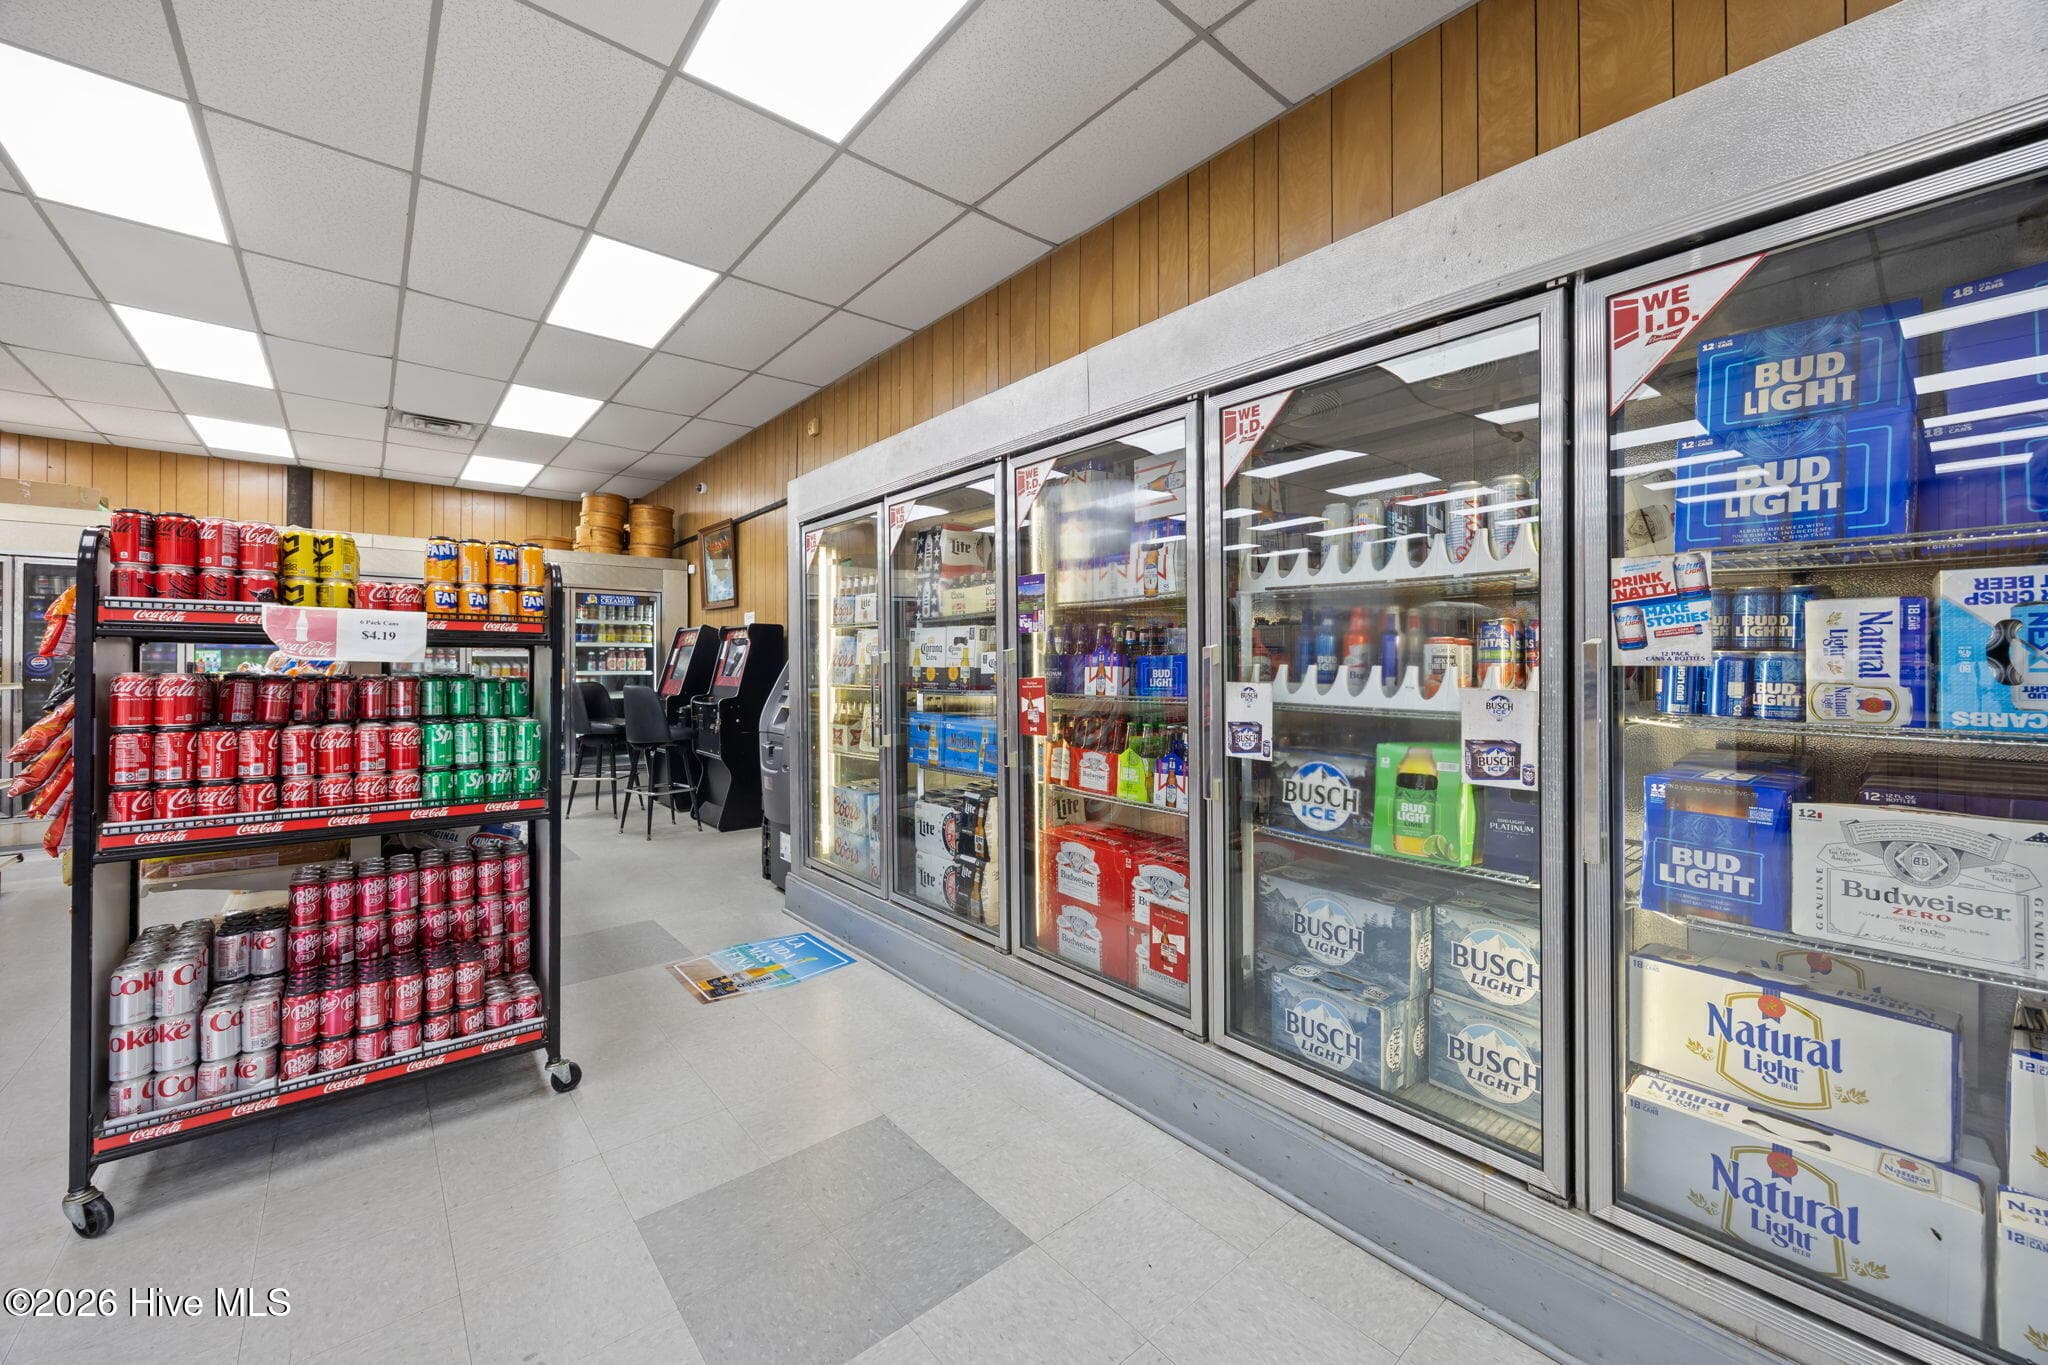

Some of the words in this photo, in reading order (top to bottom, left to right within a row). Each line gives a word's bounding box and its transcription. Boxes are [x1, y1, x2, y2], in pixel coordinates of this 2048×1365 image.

[1642, 284, 1689, 312] WE
[1953, 286, 1974, 299] 18
[1645, 306, 1700, 333] I.D.
[1702, 343, 1715, 351] 12
[1755, 352, 1846, 389] BUD
[1743, 375, 1856, 416] LIGHT
[1238, 405, 1260, 421] WE
[1239, 419, 1265, 435] I.D.
[1026, 468, 1039, 478] WE
[1737, 456, 1830, 486] BUD
[1026, 480, 1041, 490] I.D.
[1725, 482, 1842, 518] LIGHT
[951, 539, 971, 554] Lite
[1611, 571, 1663, 589] DRINK
[1974, 575, 2035, 590] BEER
[1615, 582, 1676, 600] NATTY.
[1964, 590, 2035, 606] CRISP
[133, 609, 187, 623] Coca-Cola
[1645, 602, 1691, 617] MAKE
[1908, 603, 1921, 616] 18
[483, 621, 518, 632] Coca-Cola
[1647, 611, 1712, 628] STORIES.
[361, 630, 396, 641] $4.19
[1823, 629, 1849, 657] Light
[921, 643, 942, 655] Corona
[1858, 610, 1894, 679] Natural
[1152, 669, 1171, 678] BUD
[1149, 678, 1173, 687] LIGHT
[1756, 682, 1797, 695] BUD
[1241, 692, 1258, 700] BUSCH
[1753, 694, 1802, 708] LIGHT
[1835, 687, 1852, 717] Natural
[1486, 702, 1514, 711] BUSCH
[1951, 711, 2048, 729] CARBS
[1235, 733, 1258, 742] BUSCH
[1478, 756, 1515, 767] BUSCH
[1651, 784, 1665, 792] 12
[1864, 791, 1880, 801] 12
[1284, 779, 1360, 814] BUSCH
[410, 807, 448, 819] Coca-Cola
[484, 800, 520, 813] Coca-Cola
[834, 796, 860, 821] Coors
[1053, 798, 1079, 820] Lite
[1301, 806, 1337, 821] ICE
[1400, 803, 1427, 814] BUD
[1799, 808, 1817, 818] 12
[327, 814, 370, 827] Coca-Cola
[1397, 811, 1431, 823] LIGHT
[236, 822, 284, 836] Coca-Cola
[919, 821, 935, 837] Lite
[1490, 822, 1534, 833] PLATINUM
[134, 830, 188, 844] Coca-Cola
[835, 838, 860, 864] Coors
[1672, 846, 1741, 874] BUD
[920, 871, 936, 887] Lite
[1060, 869, 1095, 888] Budweiser
[1659, 863, 1755, 896] LIGHT
[1816, 867, 1824, 930] GENUINE
[1841, 879, 2010, 921] Budweiser
[1892, 907, 1952, 922] ZERO
[1293, 914, 1363, 954] BUSCH
[2033, 897, 2046, 971] GENUINE
[1061, 933, 1097, 953] Budweiser
[1307, 938, 1348, 959] LIGHT
[1452, 943, 1541, 988] BUSCH
[1142, 964, 1186, 989] Budweiser
[1470, 973, 1525, 997] LIGHT
[1285, 1011, 1361, 1061] BUSCH
[1707, 1002, 1843, 1073] Natural
[481, 1038, 518, 1053] Coca-Cola
[1301, 1040, 1345, 1065] LIGHT
[406, 1055, 445, 1072] Coca-Cola
[1449, 1036, 1541, 1088] BUSCH
[1743, 1049, 1801, 1084] Light
[2018, 1060, 2035, 1073] 12
[323, 1075, 367, 1094] Coca-Cola
[1467, 1067, 1522, 1096] LIGHT
[1781, 1082, 1799, 1092] BEER
[1648, 1080, 1732, 1113] Natural
[232, 1097, 279, 1117] Coca-Cola
[129, 1121, 183, 1143] Coca-Cola
[1883, 1162, 1931, 1186] Natural
[1711, 1153, 1862, 1245] Natural
[1750, 1208, 1813, 1250] Light
[2007, 1230, 2025, 1246] 12
[1792, 1247, 1811, 1258] BEER
